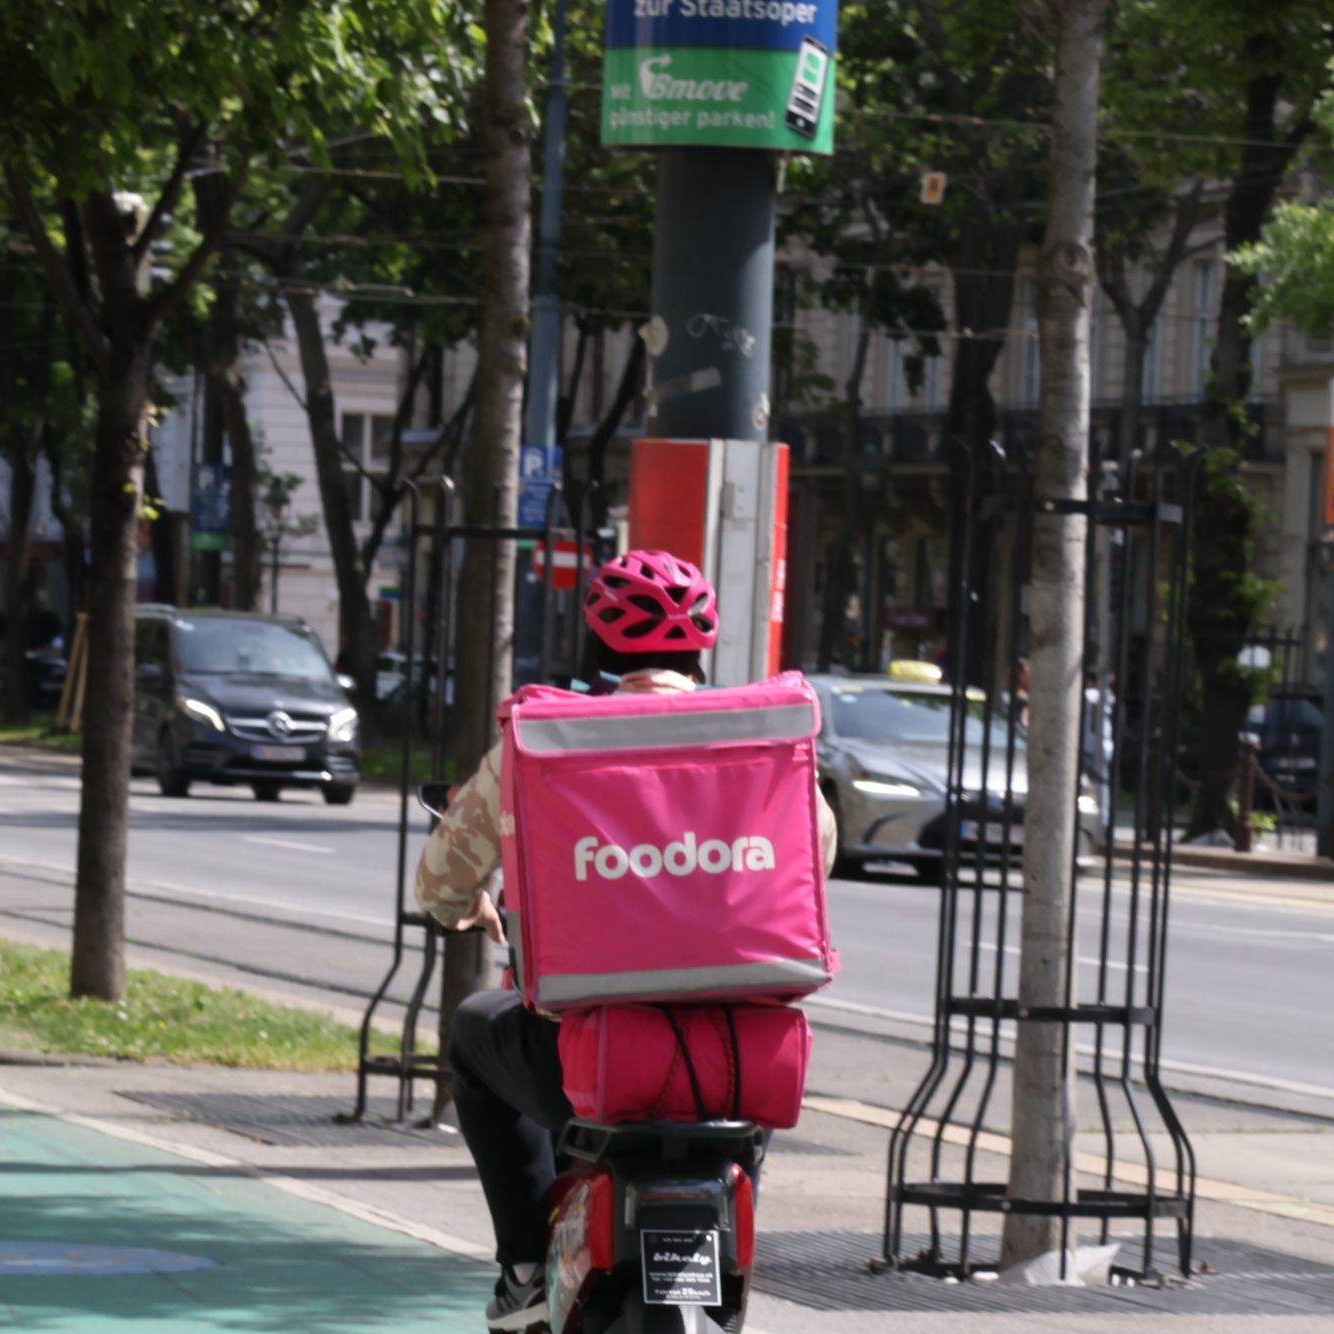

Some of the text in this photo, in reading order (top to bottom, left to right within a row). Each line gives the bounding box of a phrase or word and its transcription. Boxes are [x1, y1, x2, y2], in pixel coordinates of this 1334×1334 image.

[634, 0, 817, 25] zur Staatsoper
[697, 110, 775, 129] parken!
[573, 831, 776, 881] foodora
